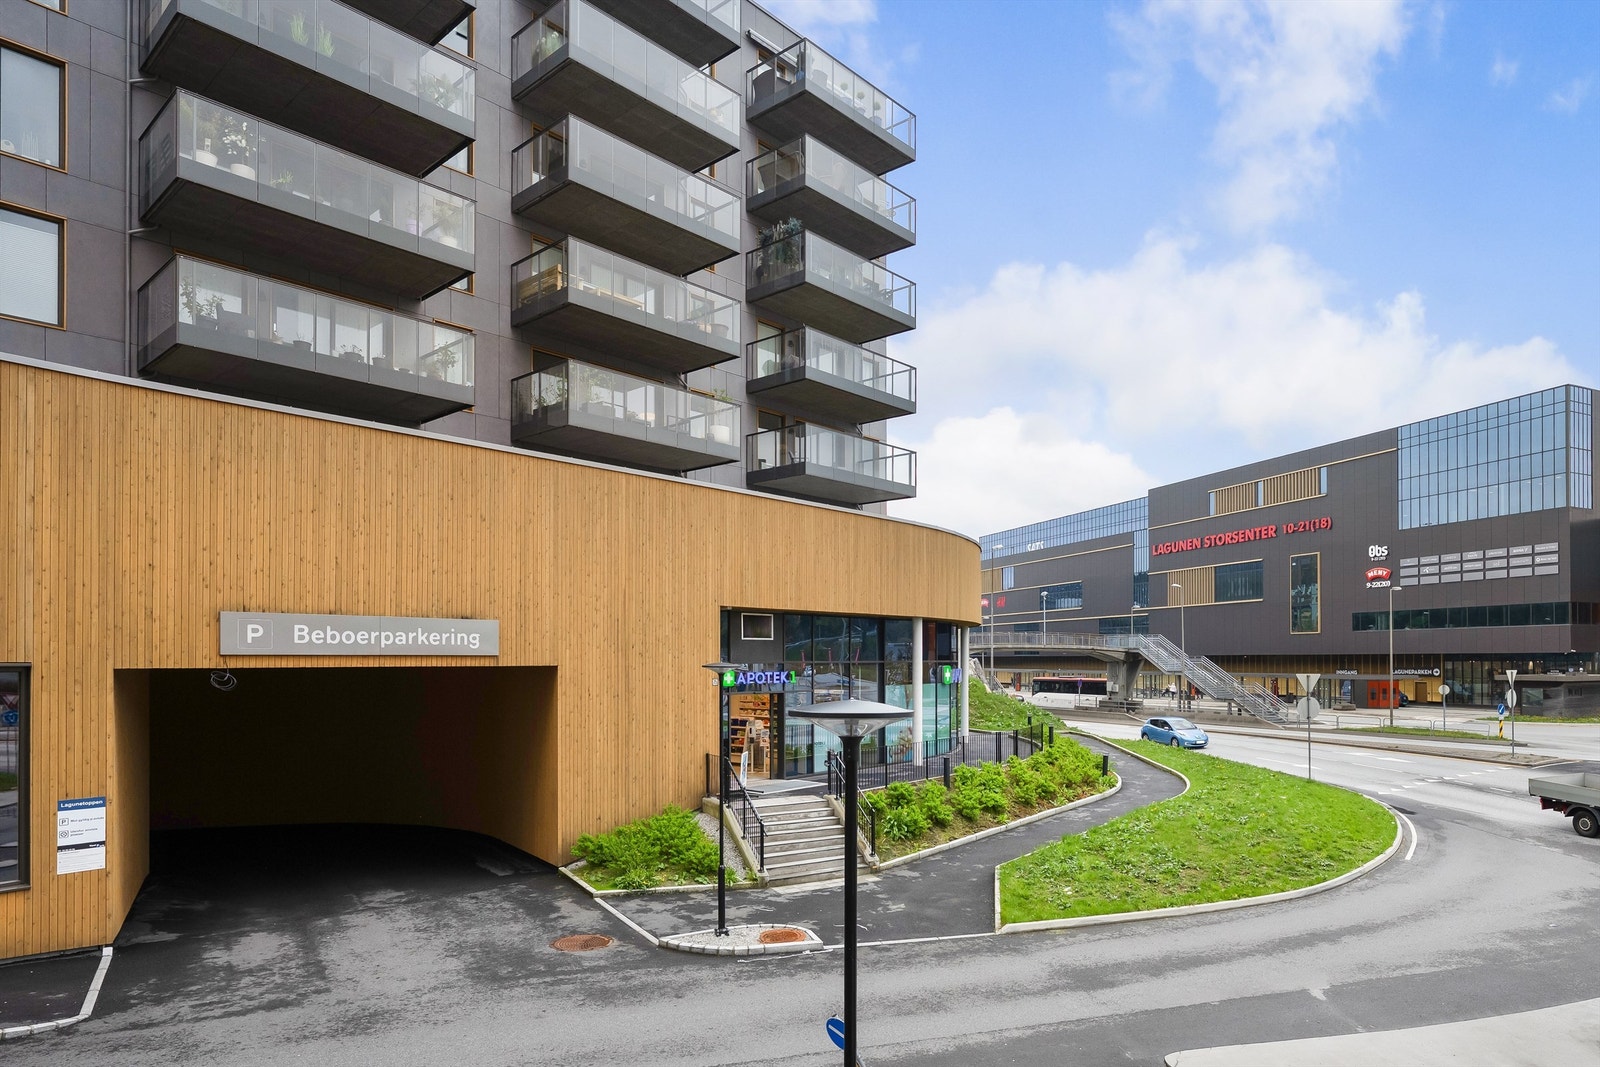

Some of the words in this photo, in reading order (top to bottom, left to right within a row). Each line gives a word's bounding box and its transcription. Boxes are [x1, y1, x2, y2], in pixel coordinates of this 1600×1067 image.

[1152, 537, 1200, 556] LAGUNEN
[1204, 525, 1277, 548] STORSENTER
[1282, 516, 1332, 535] 10-21(18)
[1367, 569, 1388, 578] MENY
[246, 624, 264, 644] P
[293, 624, 481, 649] Beboerparkering
[737, 671, 789, 685] APOTEK
